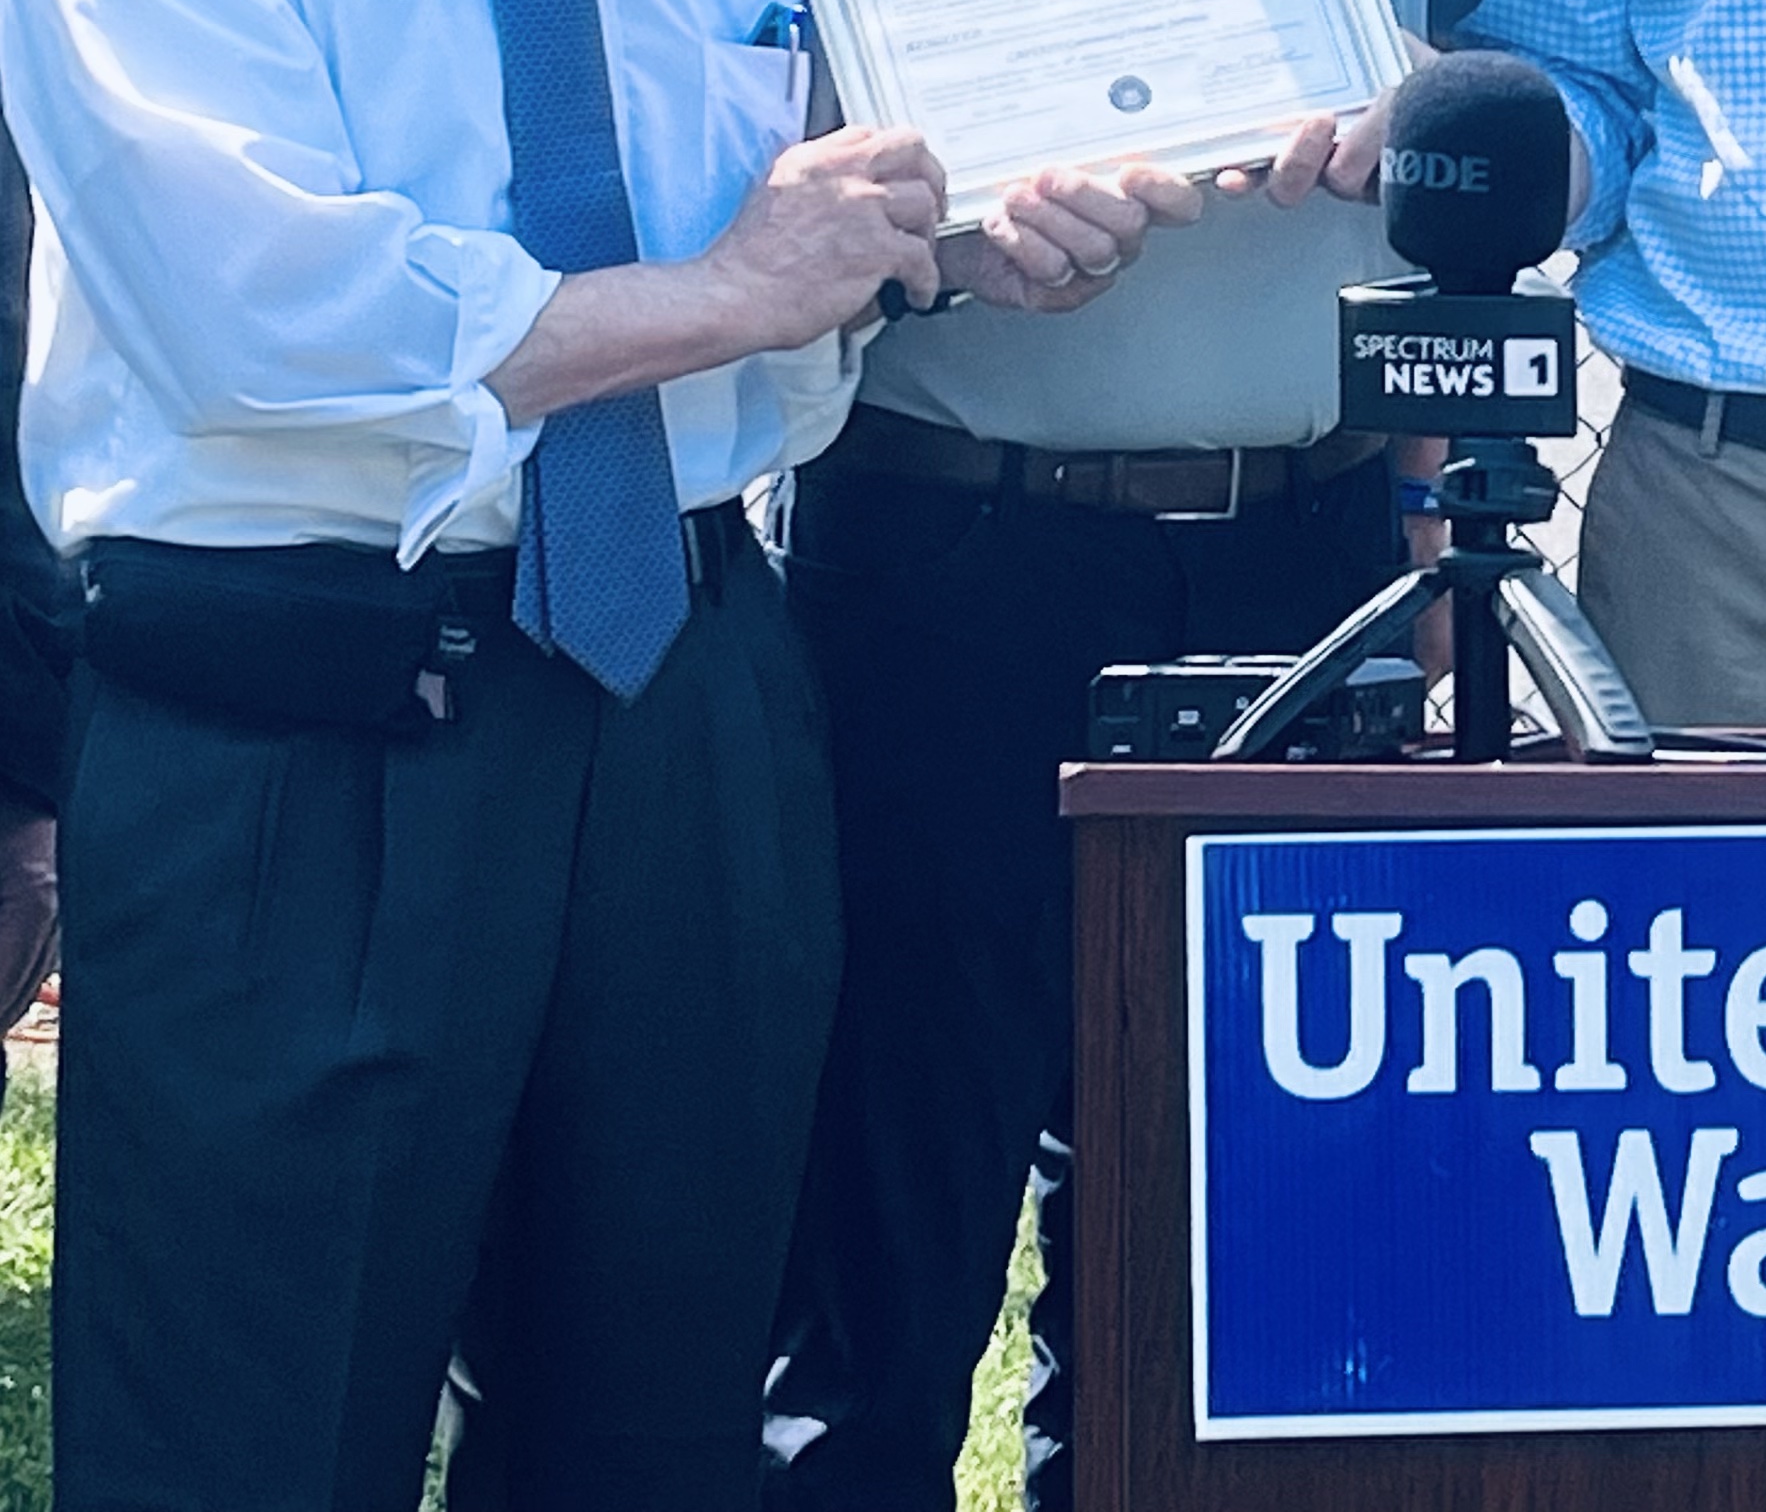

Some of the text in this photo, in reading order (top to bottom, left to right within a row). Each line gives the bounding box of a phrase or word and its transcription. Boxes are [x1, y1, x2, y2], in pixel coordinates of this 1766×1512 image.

[1353, 333, 1494, 362] SPECTRUM
[1384, 352, 1549, 397] NEWS 1
